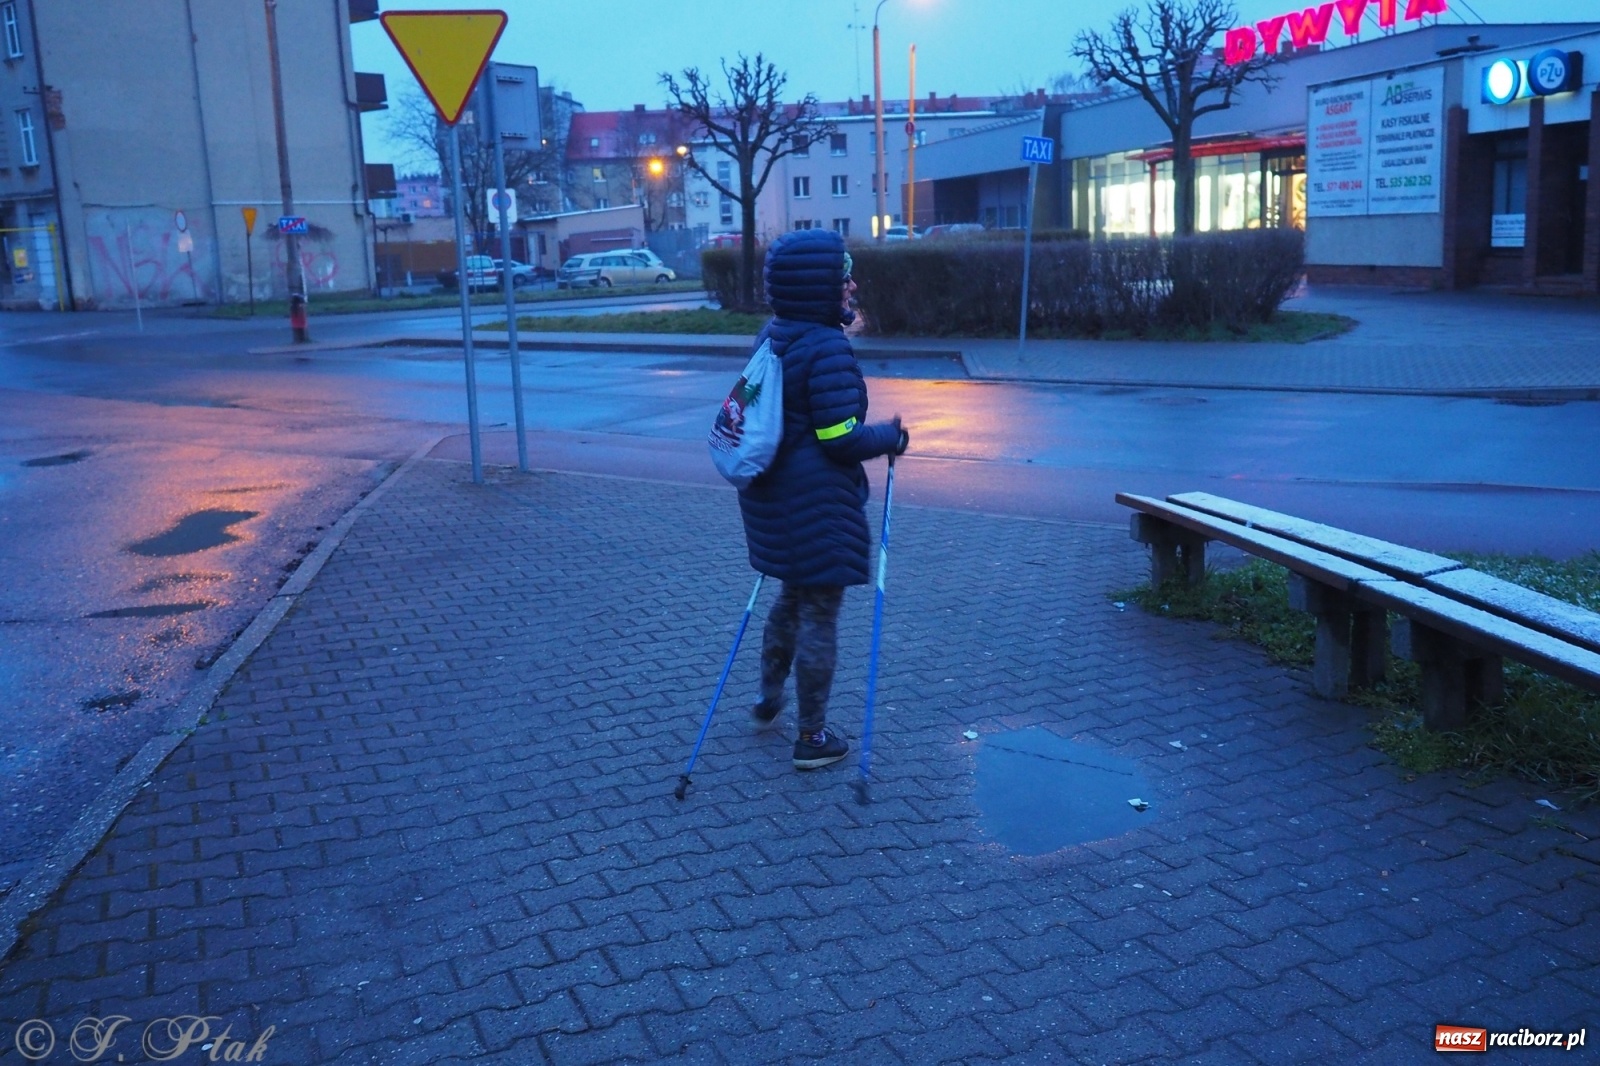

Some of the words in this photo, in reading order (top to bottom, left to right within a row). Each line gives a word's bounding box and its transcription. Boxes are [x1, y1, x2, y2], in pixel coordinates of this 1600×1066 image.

[1540, 62, 1563, 83] PZU
[1381, 117, 1397, 129] KASY
[1398, 112, 1431, 126] FISKALNE
[1024, 139, 1052, 160] TAXI
[281, 219, 306, 231] TAXI
